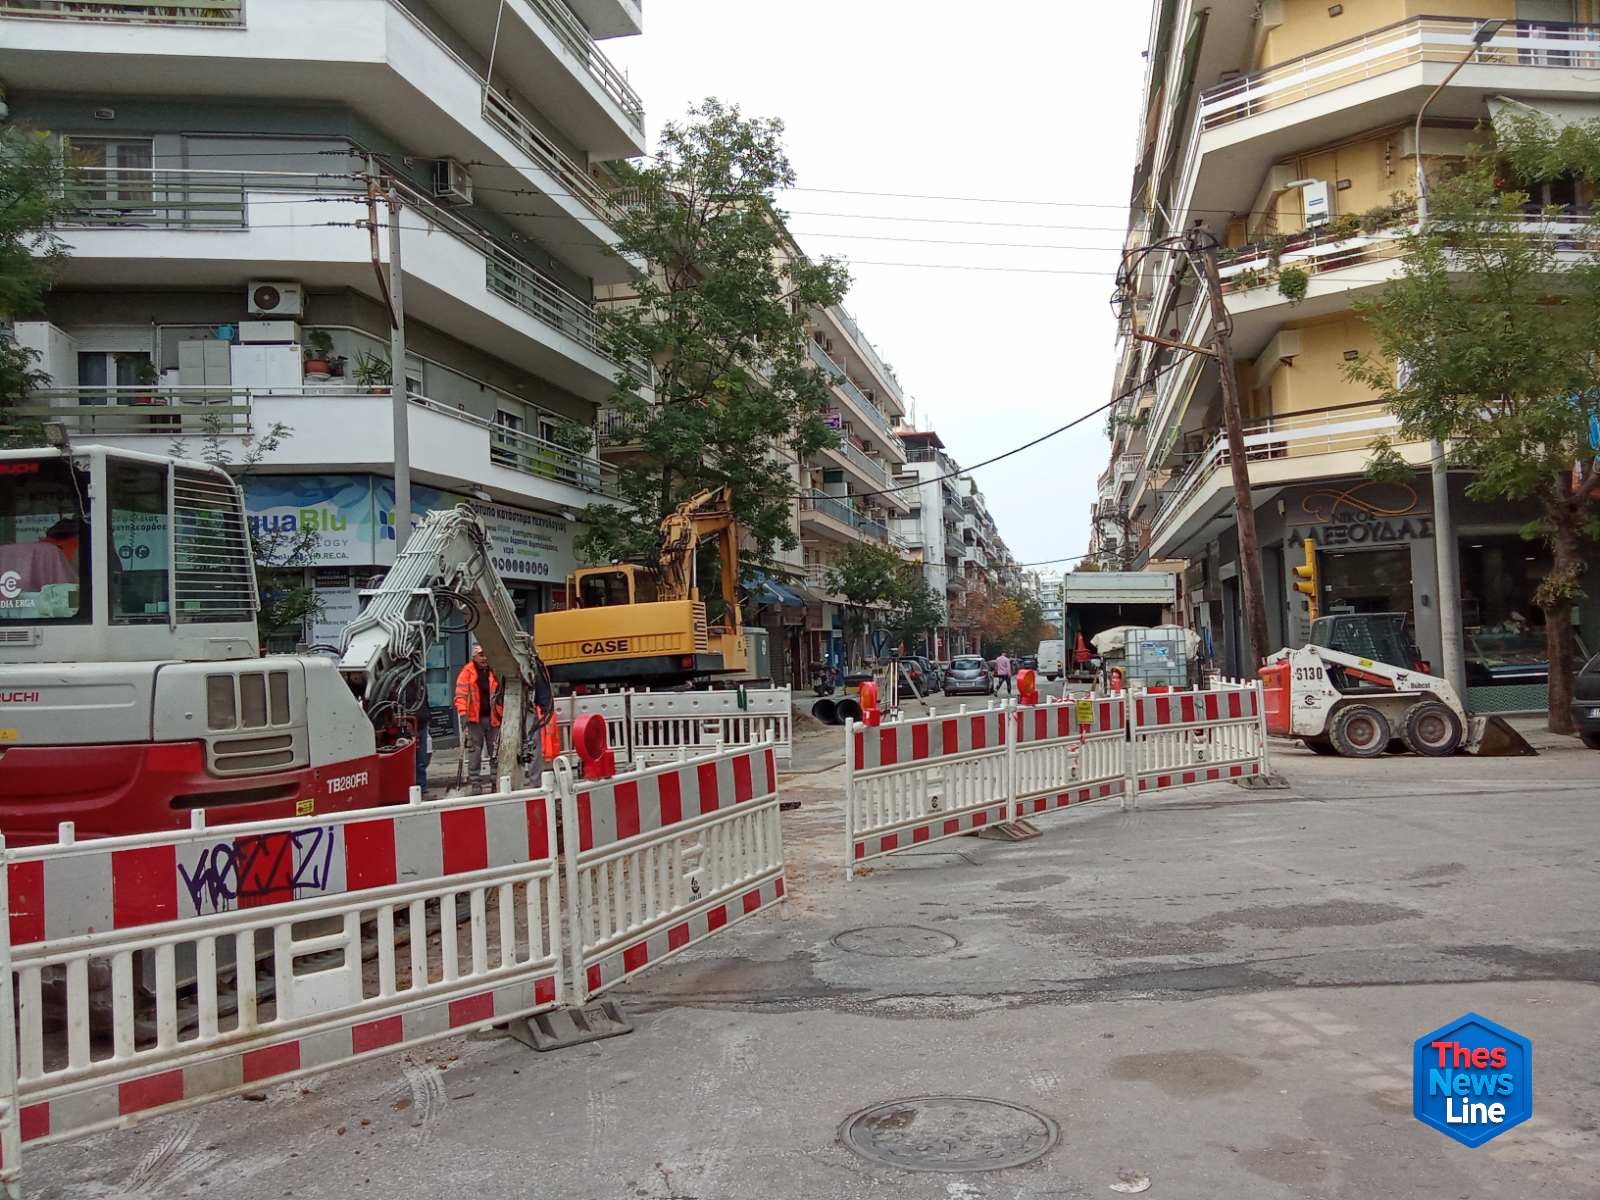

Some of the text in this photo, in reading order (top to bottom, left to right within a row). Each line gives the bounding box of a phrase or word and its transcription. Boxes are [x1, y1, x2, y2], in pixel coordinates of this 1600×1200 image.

[248, 508, 347, 537] quaBlu
[581, 639, 629, 655] CASE
[1296, 666, 1323, 681] S130
[326, 771, 369, 794] TB280FR
